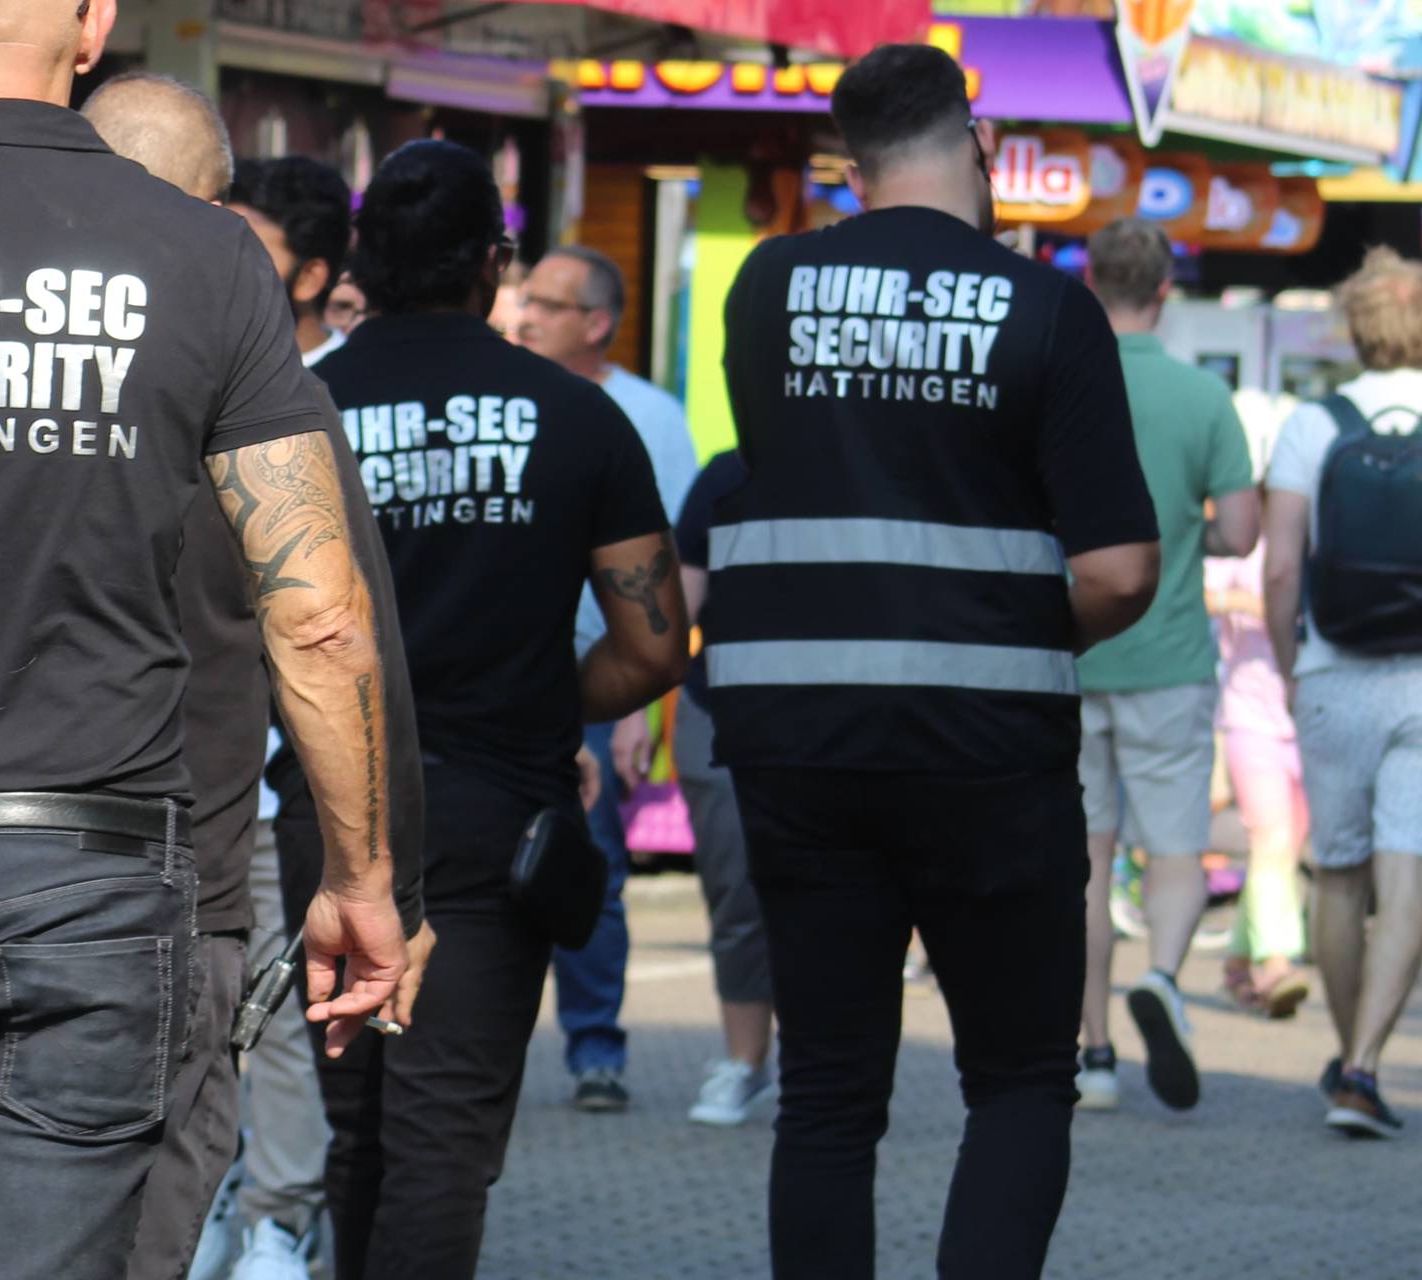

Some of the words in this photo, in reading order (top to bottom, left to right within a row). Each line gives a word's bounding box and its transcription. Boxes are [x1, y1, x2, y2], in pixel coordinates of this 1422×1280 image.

[787, 266, 1013, 323] RUHR-SEC
[789, 315, 999, 375] SECURITY
[784, 370, 999, 409] HATTINGEN
[360, 443, 530, 505] CURITY
[373, 496, 534, 530] TINGEN
